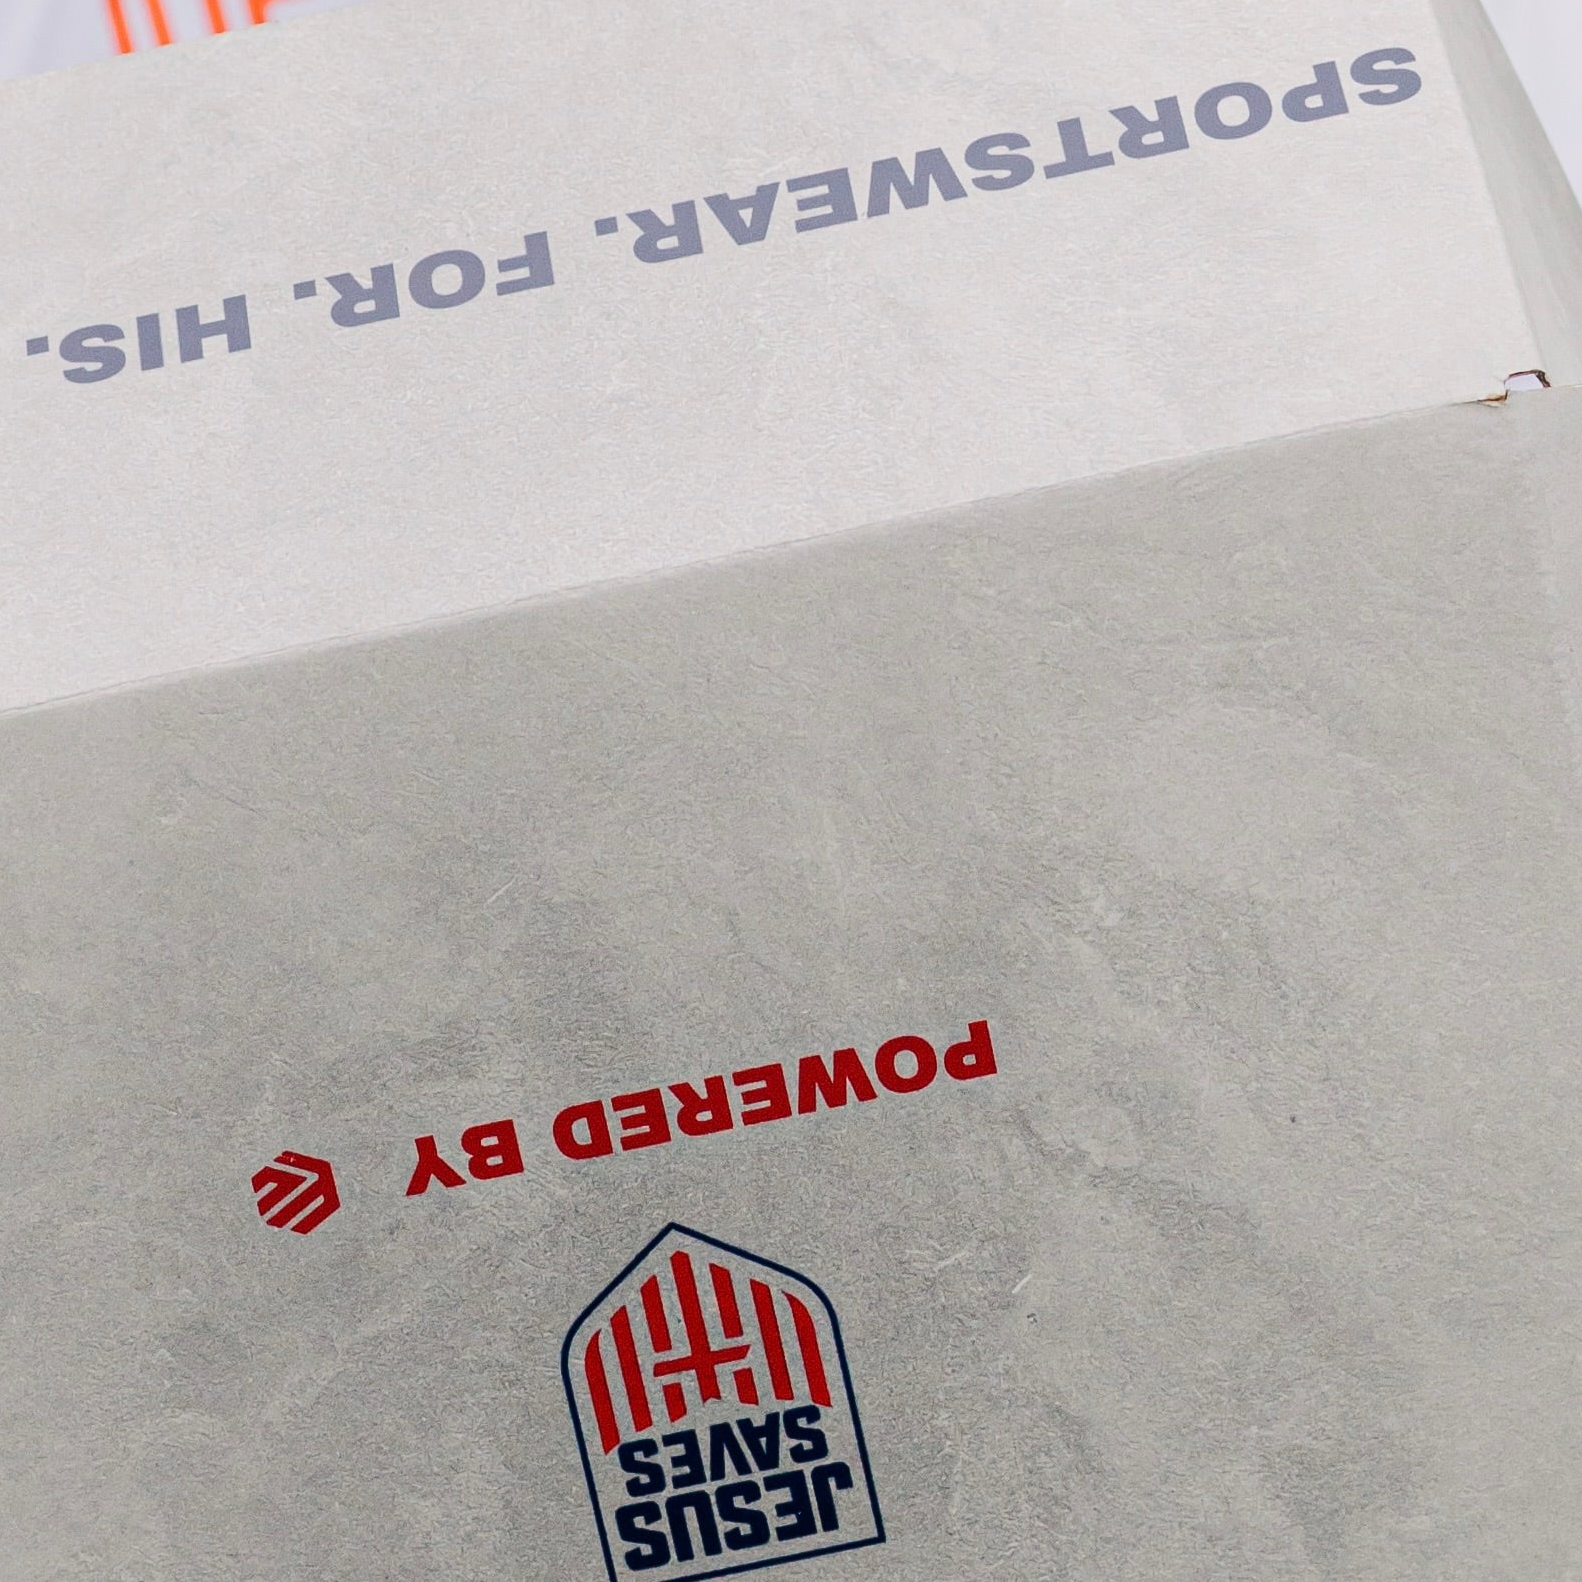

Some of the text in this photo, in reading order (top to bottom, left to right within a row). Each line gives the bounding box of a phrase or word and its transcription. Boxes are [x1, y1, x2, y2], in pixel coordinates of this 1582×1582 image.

[594, 46, 1423, 264] SPORTSWEAR.
[291, 229, 557, 328] FOR.
[24, 293, 253, 384] HIS.
[405, 1019, 998, 1198] POWERED BY
[617, 1404, 829, 1498] SAVES
[614, 1461, 854, 1572] JESUS
